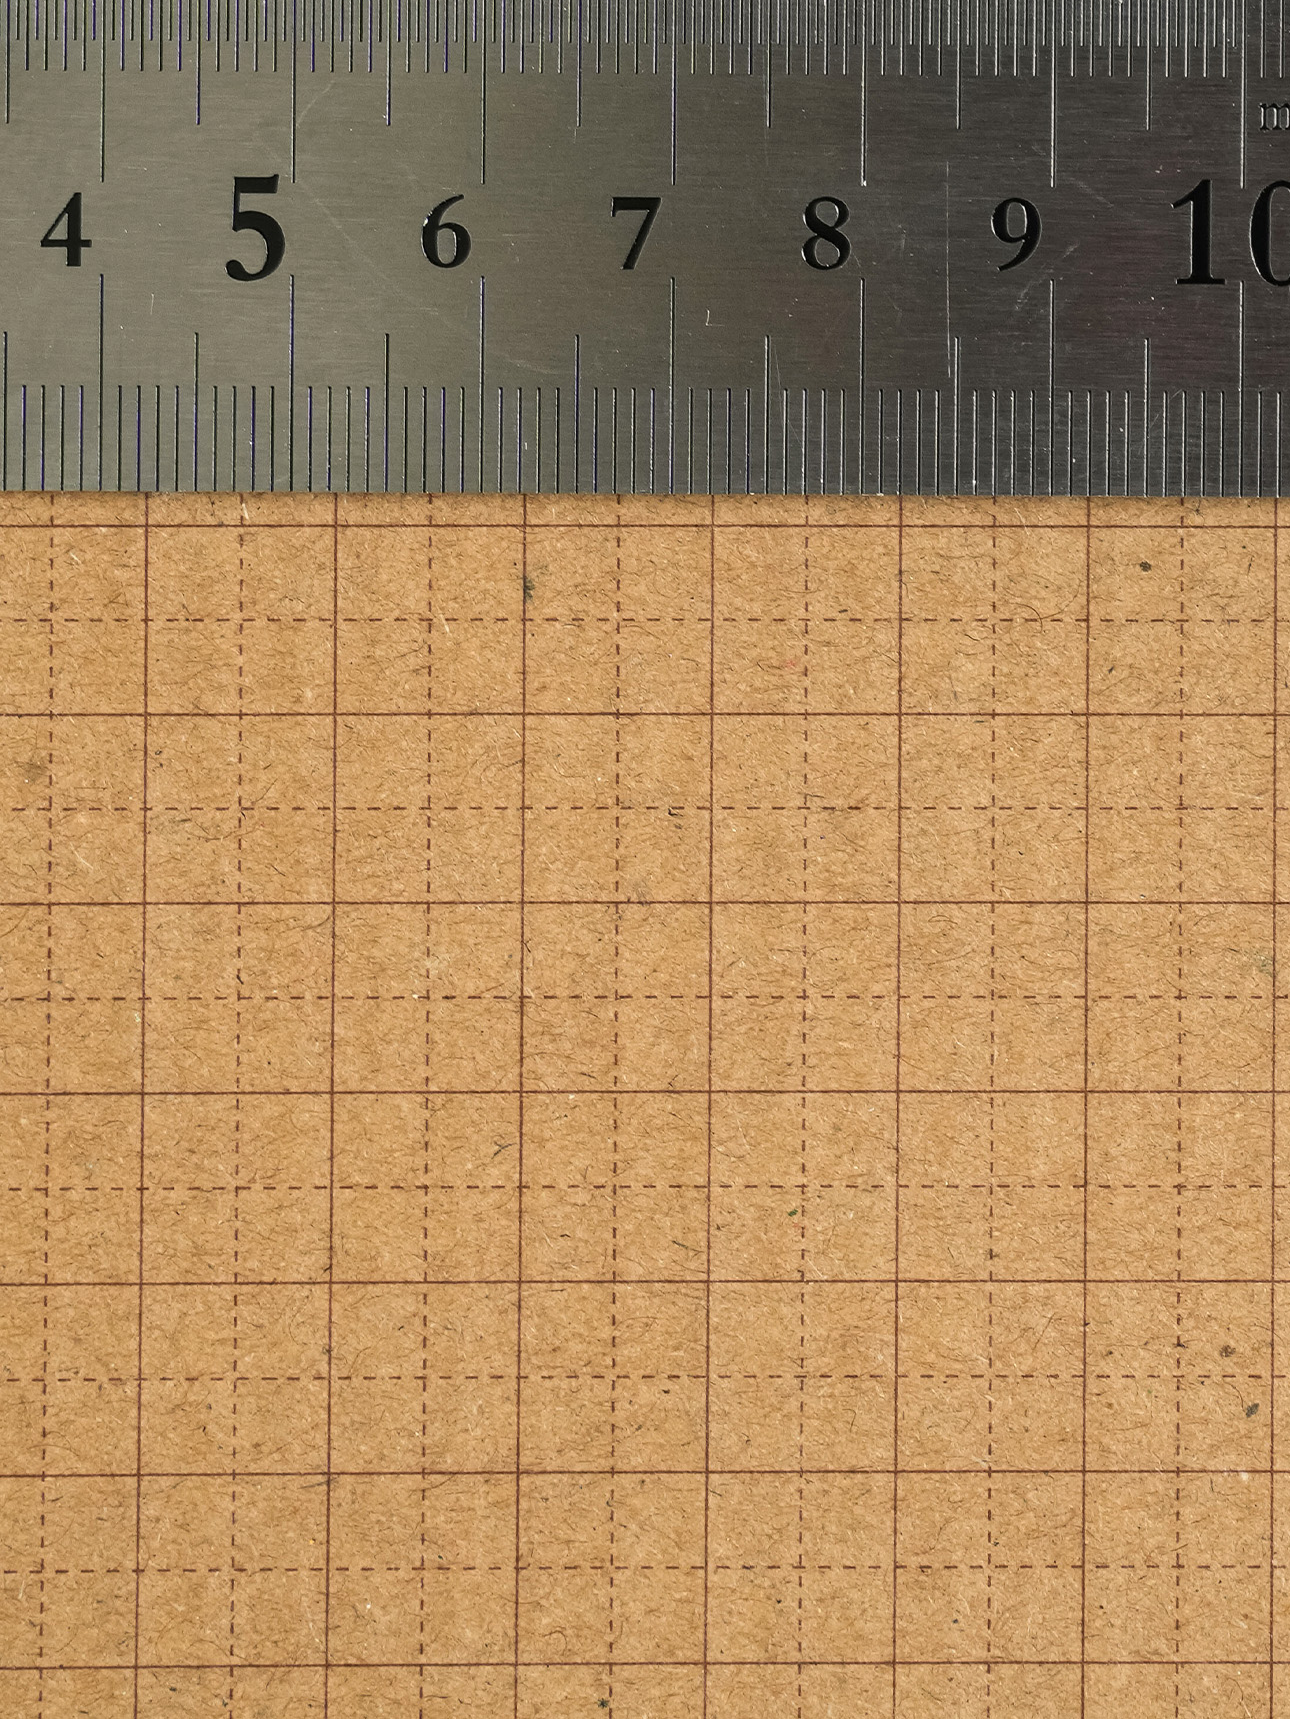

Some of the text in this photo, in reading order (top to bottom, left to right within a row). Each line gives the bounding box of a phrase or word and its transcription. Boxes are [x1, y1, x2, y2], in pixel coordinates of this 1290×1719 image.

[41, 193, 91, 266] 4
[226, 175, 283, 281] 5
[423, 195, 470, 268] 6
[612, 197, 661, 269] 7
[803, 197, 849, 270] 8
[993, 198, 1040, 271] 9
